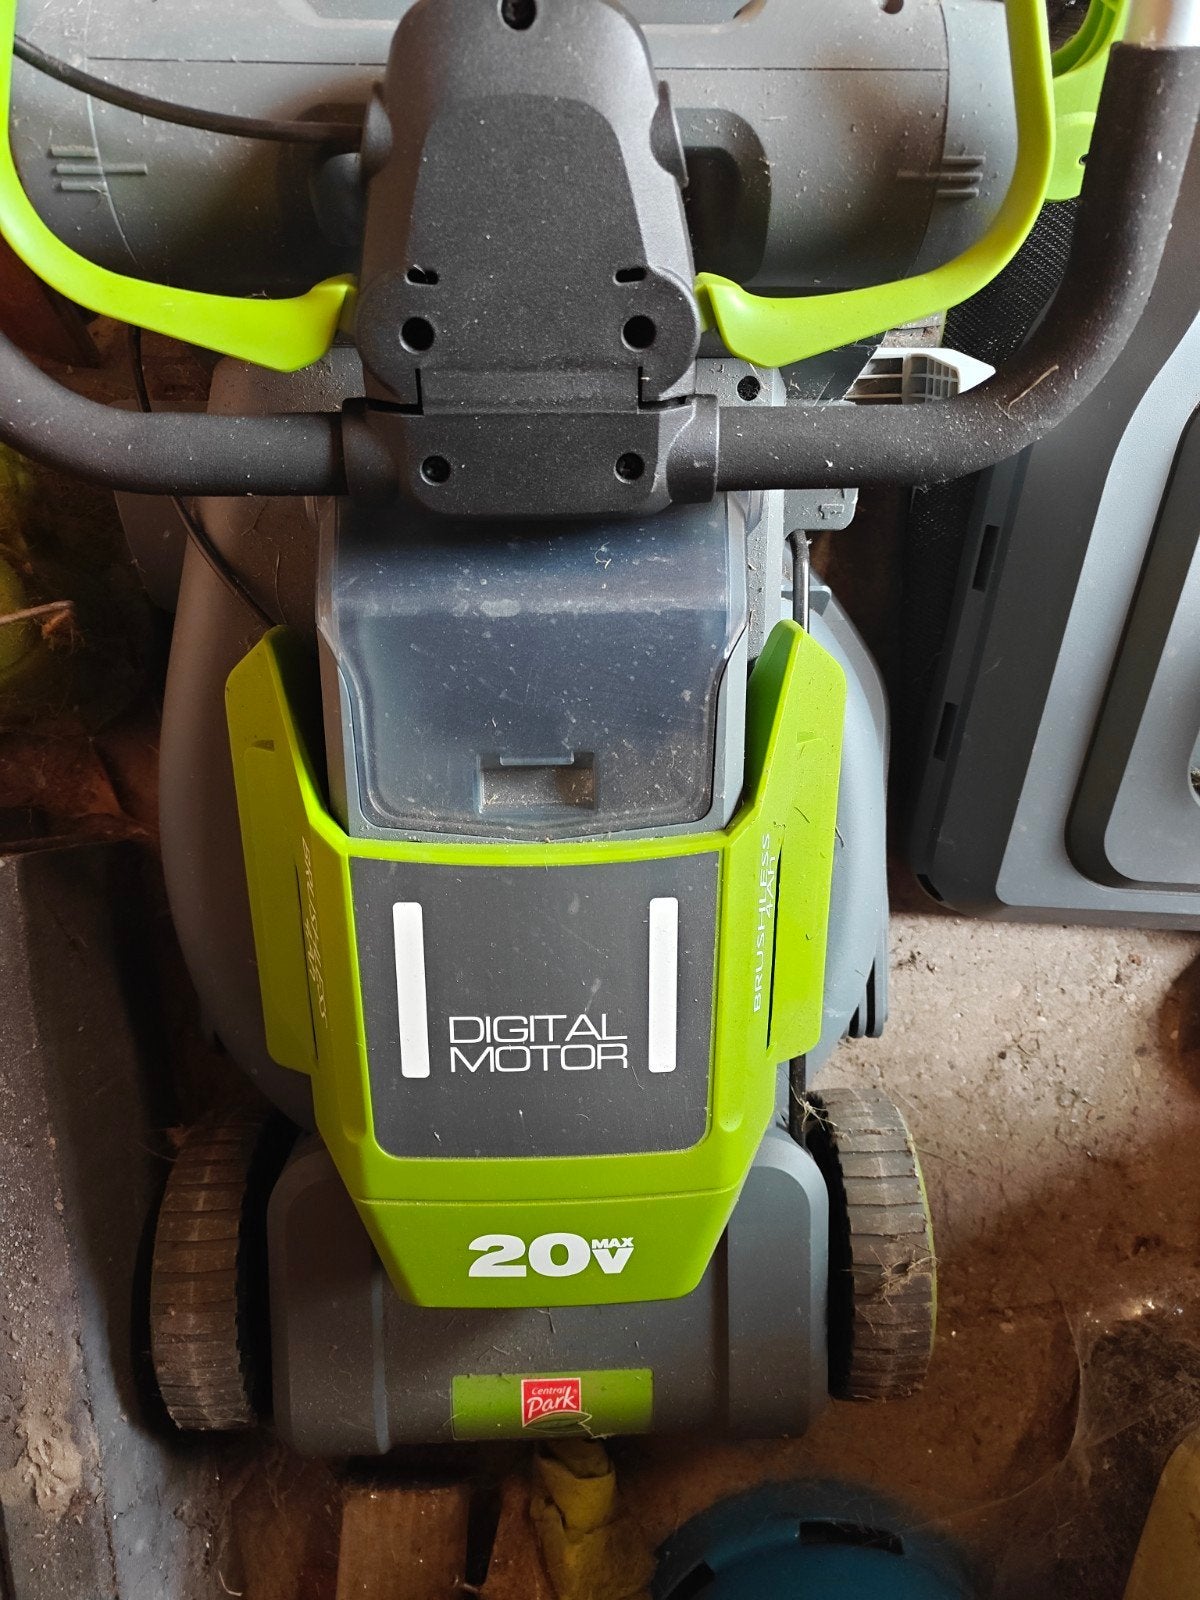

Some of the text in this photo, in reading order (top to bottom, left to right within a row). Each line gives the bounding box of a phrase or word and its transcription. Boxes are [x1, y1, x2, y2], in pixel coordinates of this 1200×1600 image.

[752, 833, 771, 1013] BRUSHLESS
[448, 1013, 628, 1044] DIGITAL
[449, 1043, 628, 1073] MOTOR
[591, 1237, 634, 1250] MAX
[526, 1385, 578, 1419] Park
[531, 1385, 568, 1395] Central
